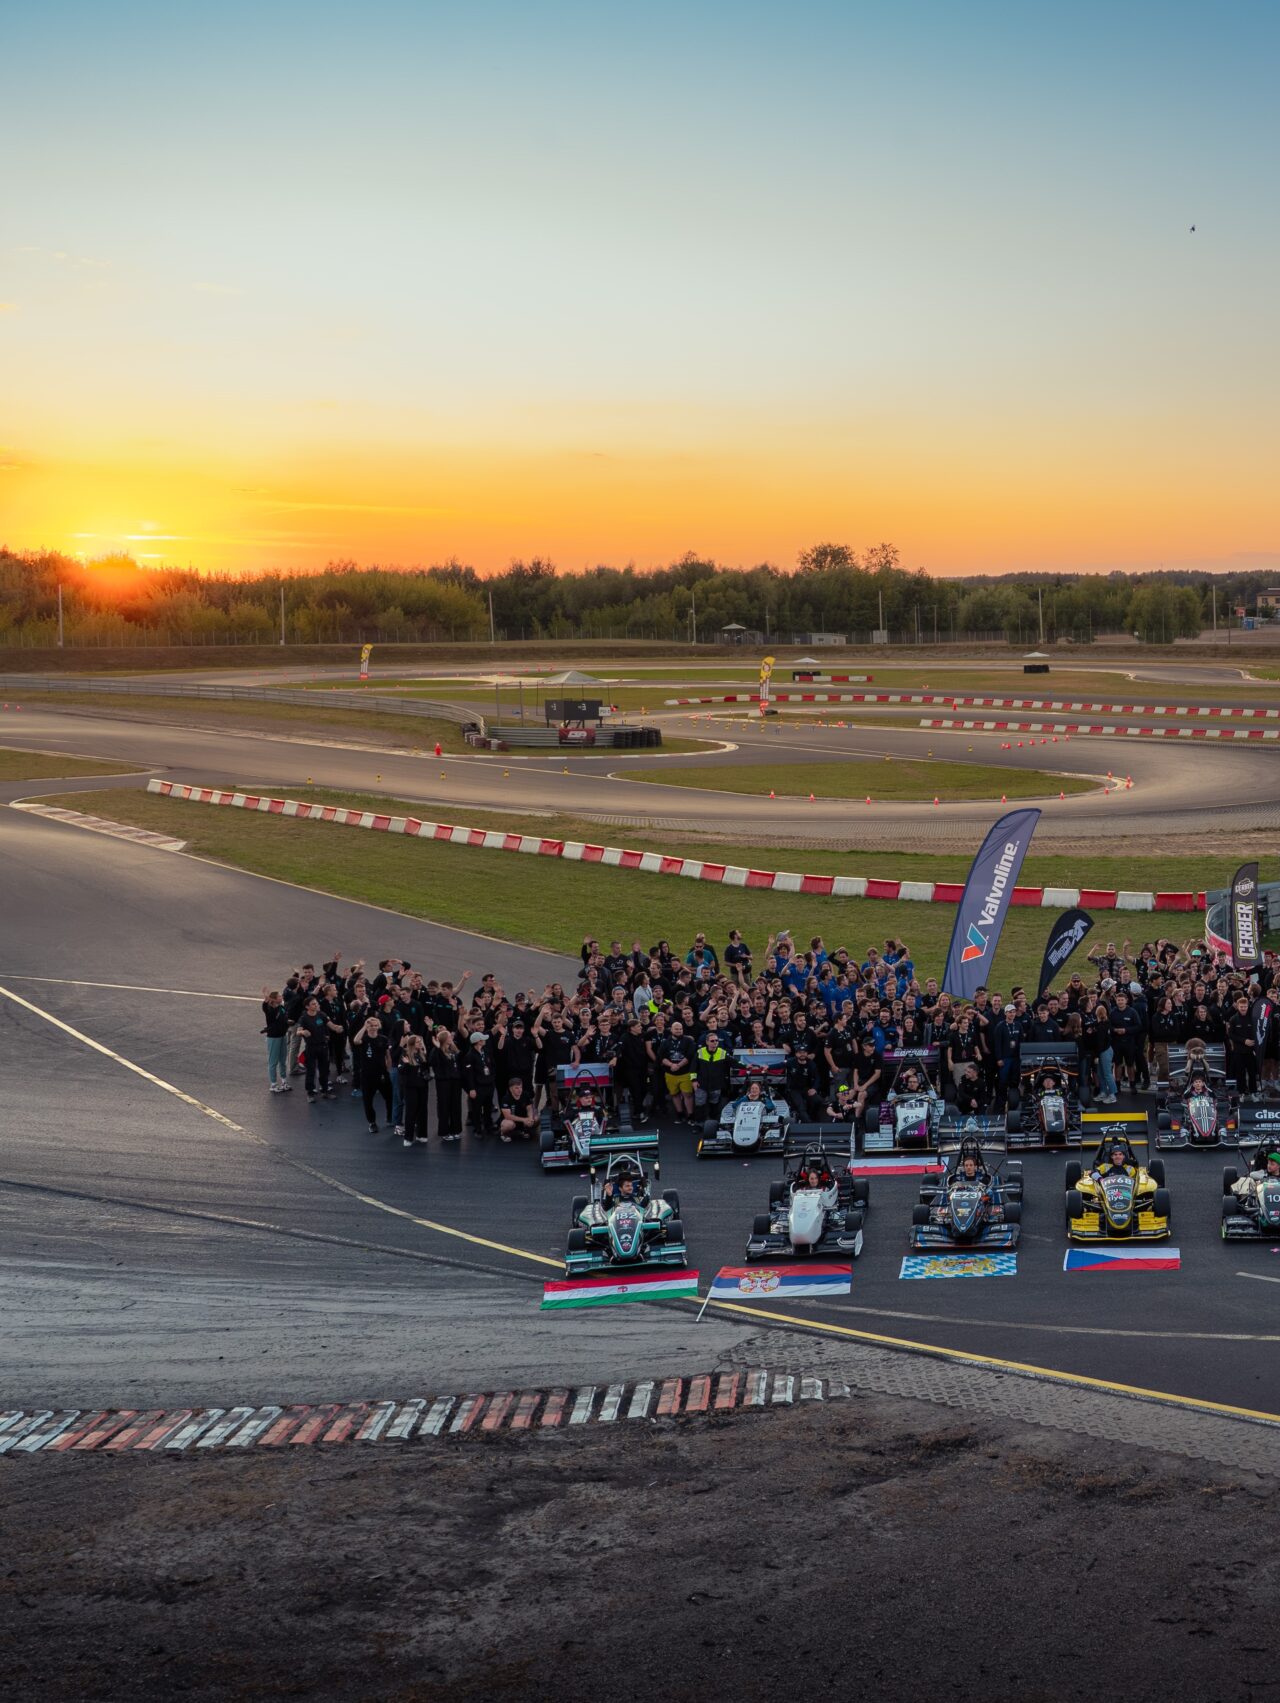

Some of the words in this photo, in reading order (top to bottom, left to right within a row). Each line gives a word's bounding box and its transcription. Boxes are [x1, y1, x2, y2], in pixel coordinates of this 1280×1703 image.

[977, 842, 1018, 926] Valvoline
[1237, 903, 1256, 957] CERBER
[954, 1191, 979, 1200] E23
[615, 1213, 638, 1221] 182
